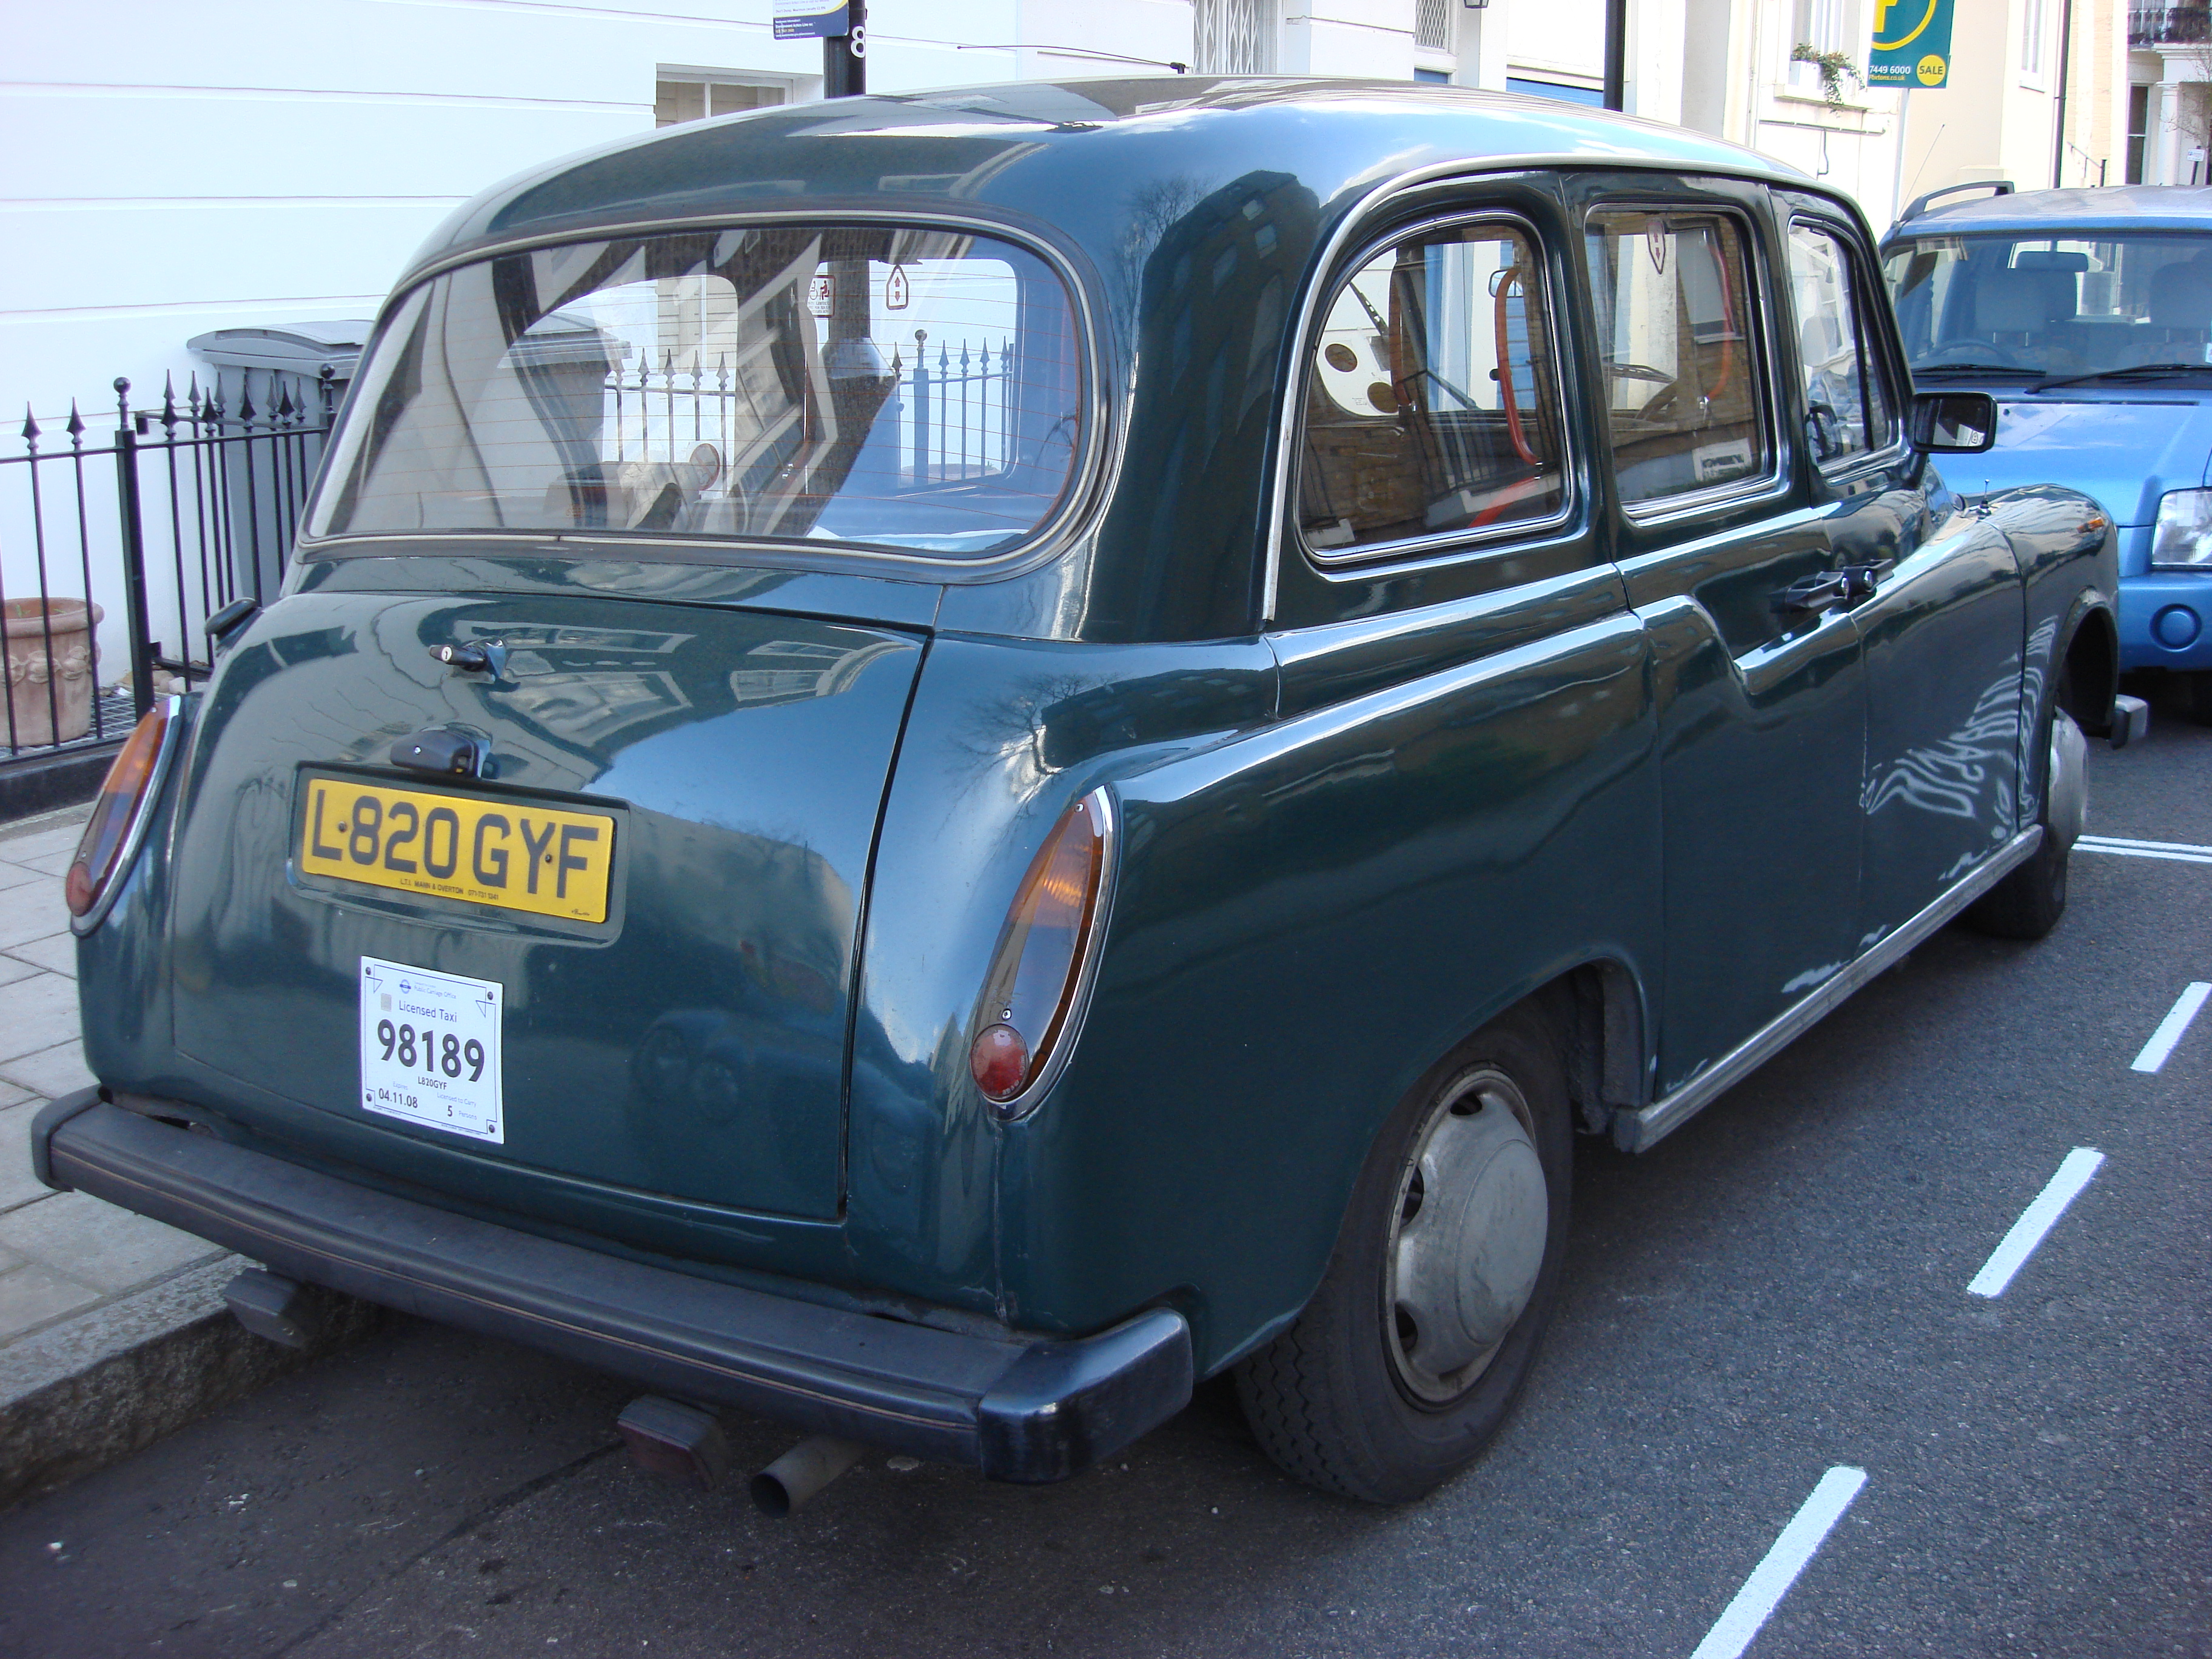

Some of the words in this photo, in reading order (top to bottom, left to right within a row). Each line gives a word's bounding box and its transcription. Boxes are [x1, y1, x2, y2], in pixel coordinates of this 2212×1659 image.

[851, 25, 865, 58] 8
[1869, 65, 1888, 75] 7449
[1890, 66, 1911, 75] 6000
[1919, 65, 1943, 75] SALE
[312, 789, 459, 880] L820
[472, 813, 599, 899] GYF
[414, 880, 431, 889] MANN
[437, 884, 464, 894] OVERTON
[399, 1000, 436, 1018] Licensed
[439, 1009, 457, 1023] Taxi
[377, 1019, 485, 1082] 98189
[393, 1081, 409, 1090] Expires
[418, 1076, 447, 1090] L820GYF
[378, 1088, 418, 1108] 04.11.08
[437, 1092, 457, 1102] Licensed
[464, 1099, 477, 1108] Carry
[447, 1105, 453, 1117] 5
[458, 1110, 477, 1121] Persons
